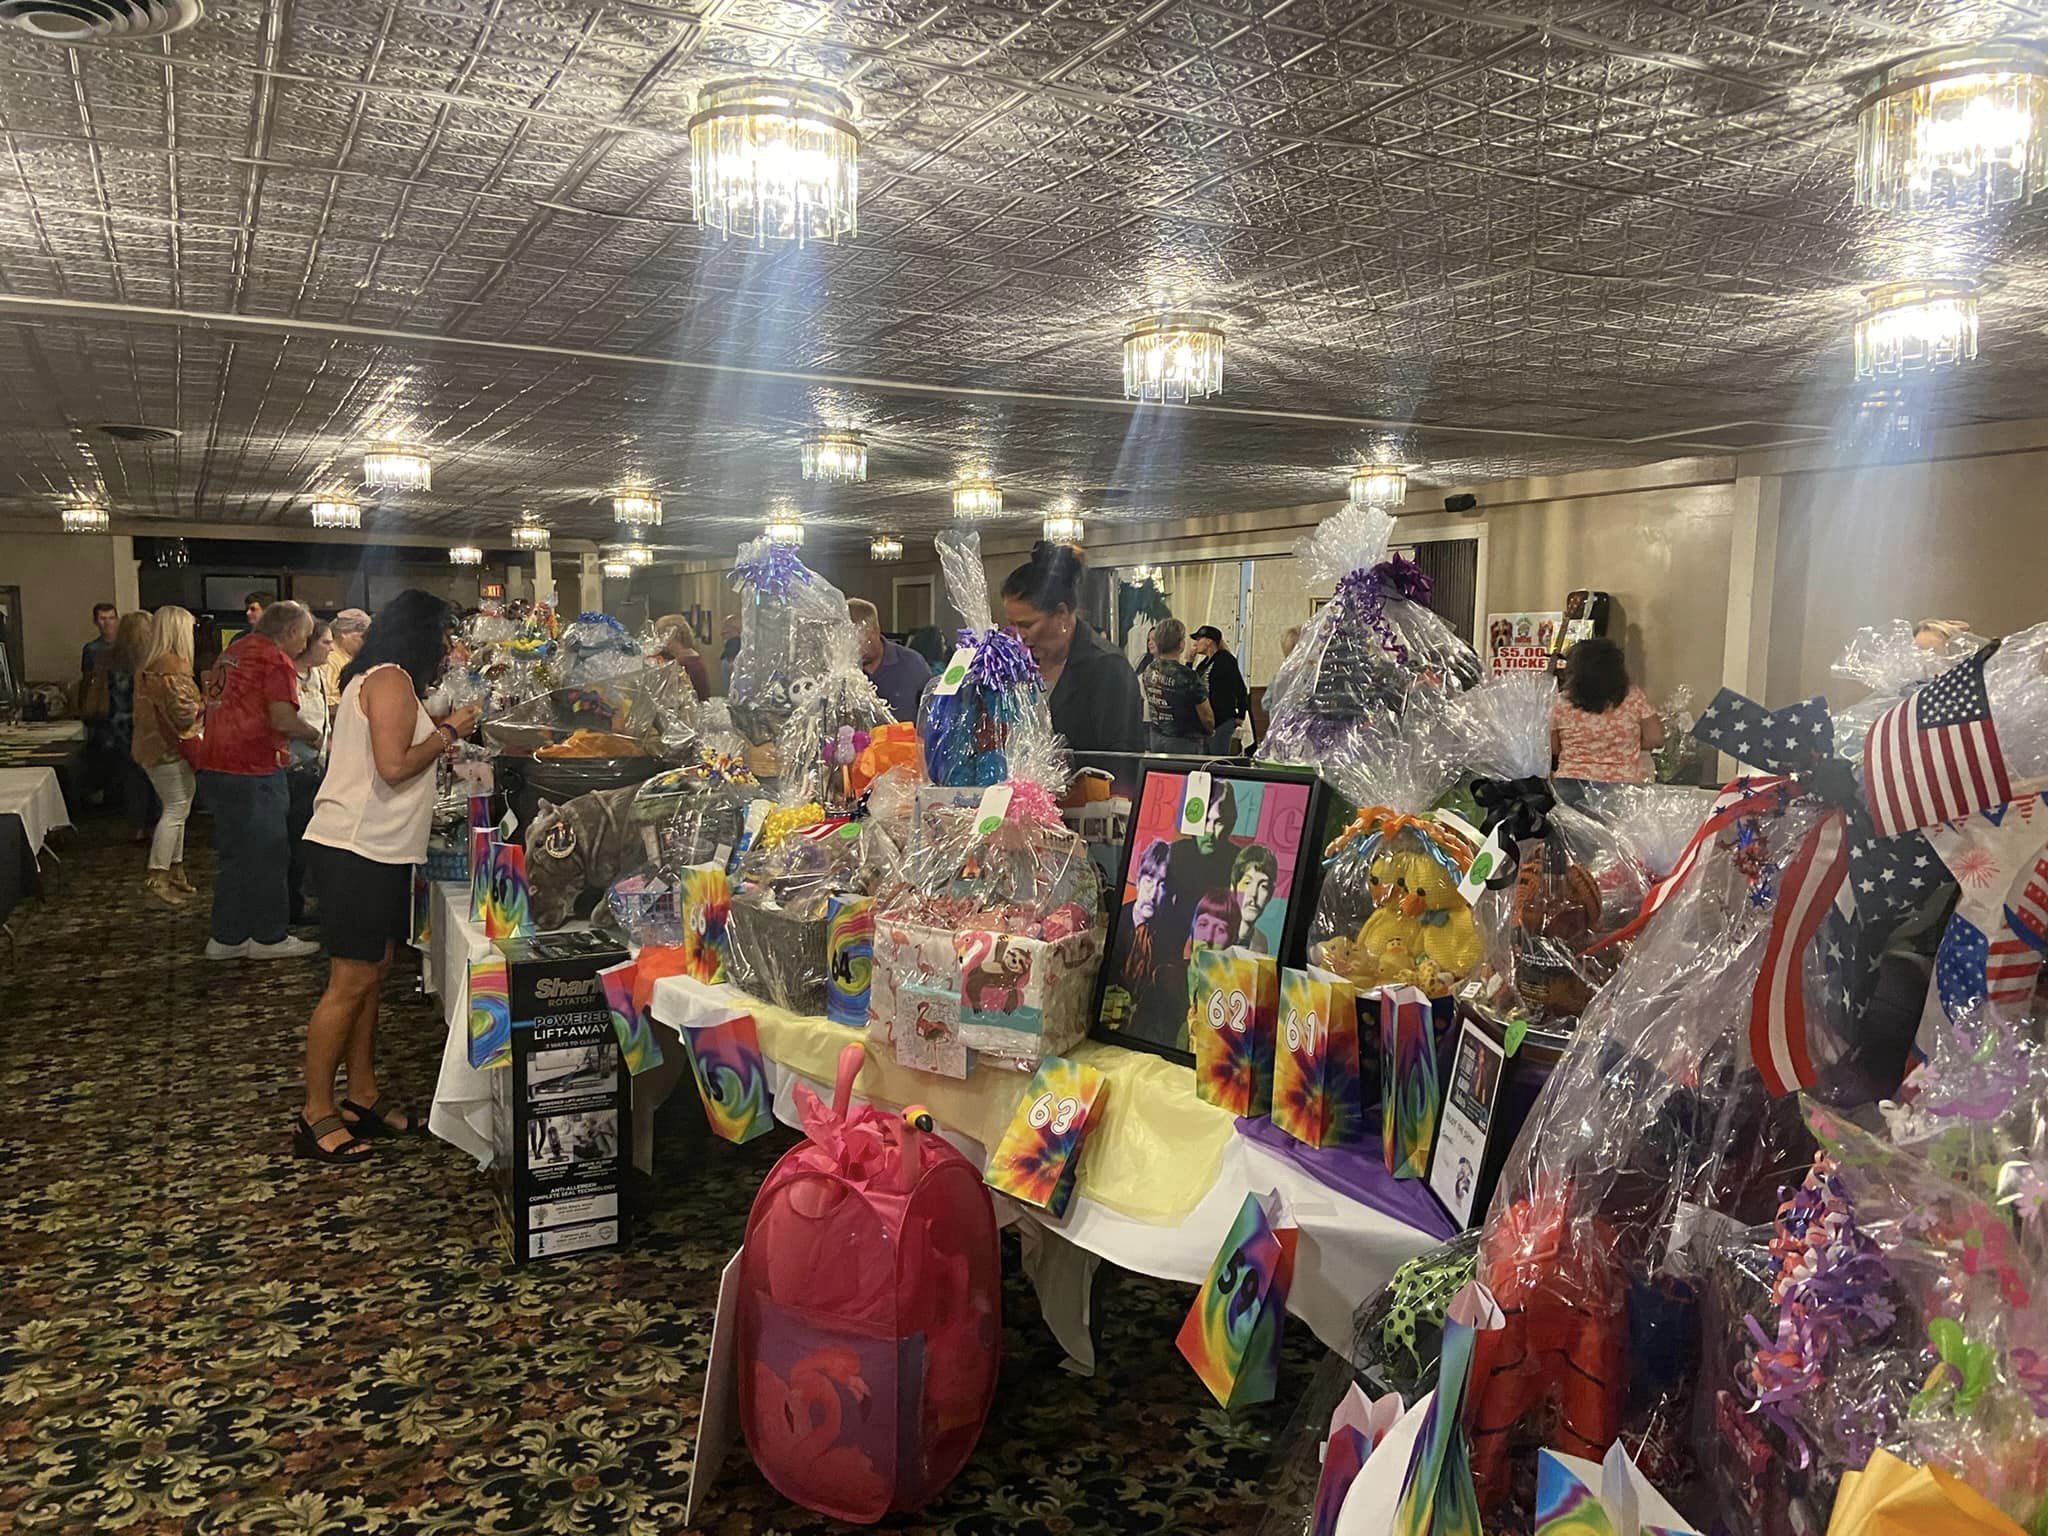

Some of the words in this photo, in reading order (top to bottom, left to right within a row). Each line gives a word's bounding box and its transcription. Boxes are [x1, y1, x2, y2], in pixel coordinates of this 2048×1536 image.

[1493, 658, 1502, 668] A
[1504, 658, 1546, 668] TICKE
[1500, 647, 1545, 657] $5.00
[689, 905, 706, 935] 66
[831, 950, 852, 984] 64
[534, 1010, 610, 1028] POWERED
[1207, 989, 1249, 1033] 62
[534, 1023, 609, 1041] LIFT-AWAY
[1284, 1008, 1318, 1056] 61
[1027, 1092, 1080, 1135] 63
[1217, 1247, 1259, 1317] 59
